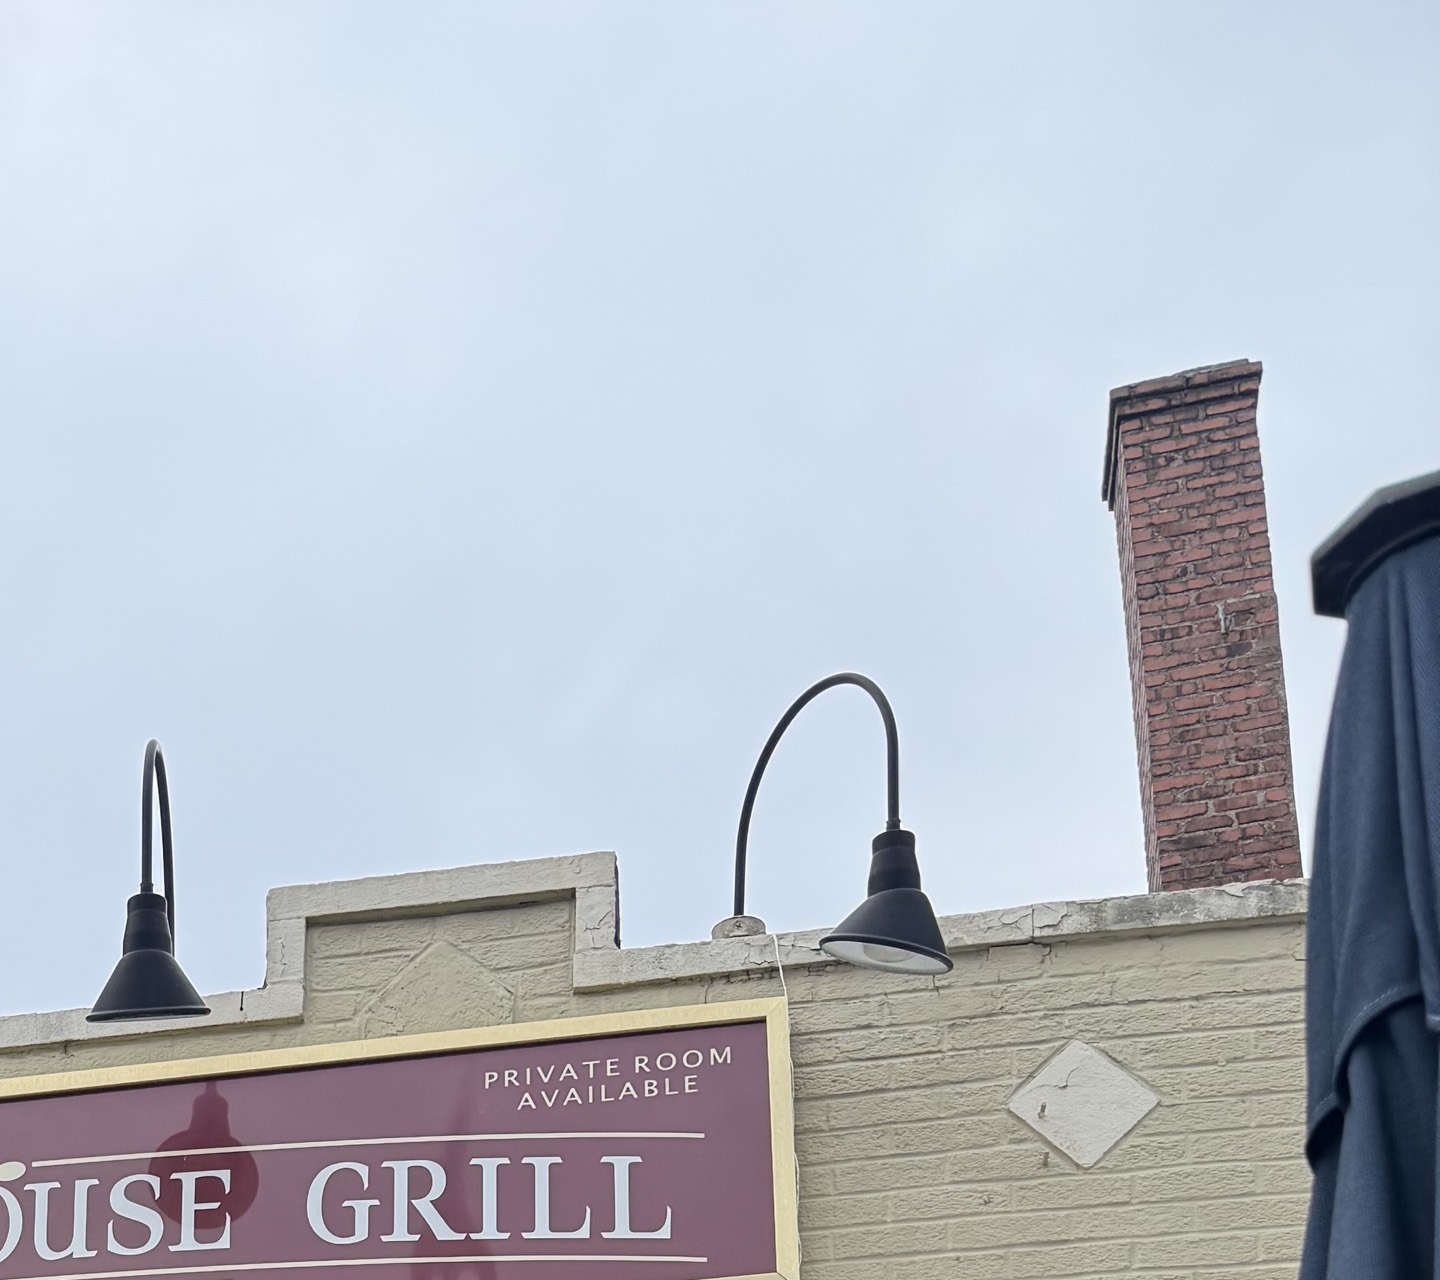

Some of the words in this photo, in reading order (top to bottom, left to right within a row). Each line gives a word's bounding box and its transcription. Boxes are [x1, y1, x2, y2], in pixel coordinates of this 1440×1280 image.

[484, 1059, 623, 1091] PRIVATE
[633, 1046, 734, 1074] ROOM
[516, 1076, 701, 1112] AVAILABLE
[305, 1154, 674, 1247] GRILL
